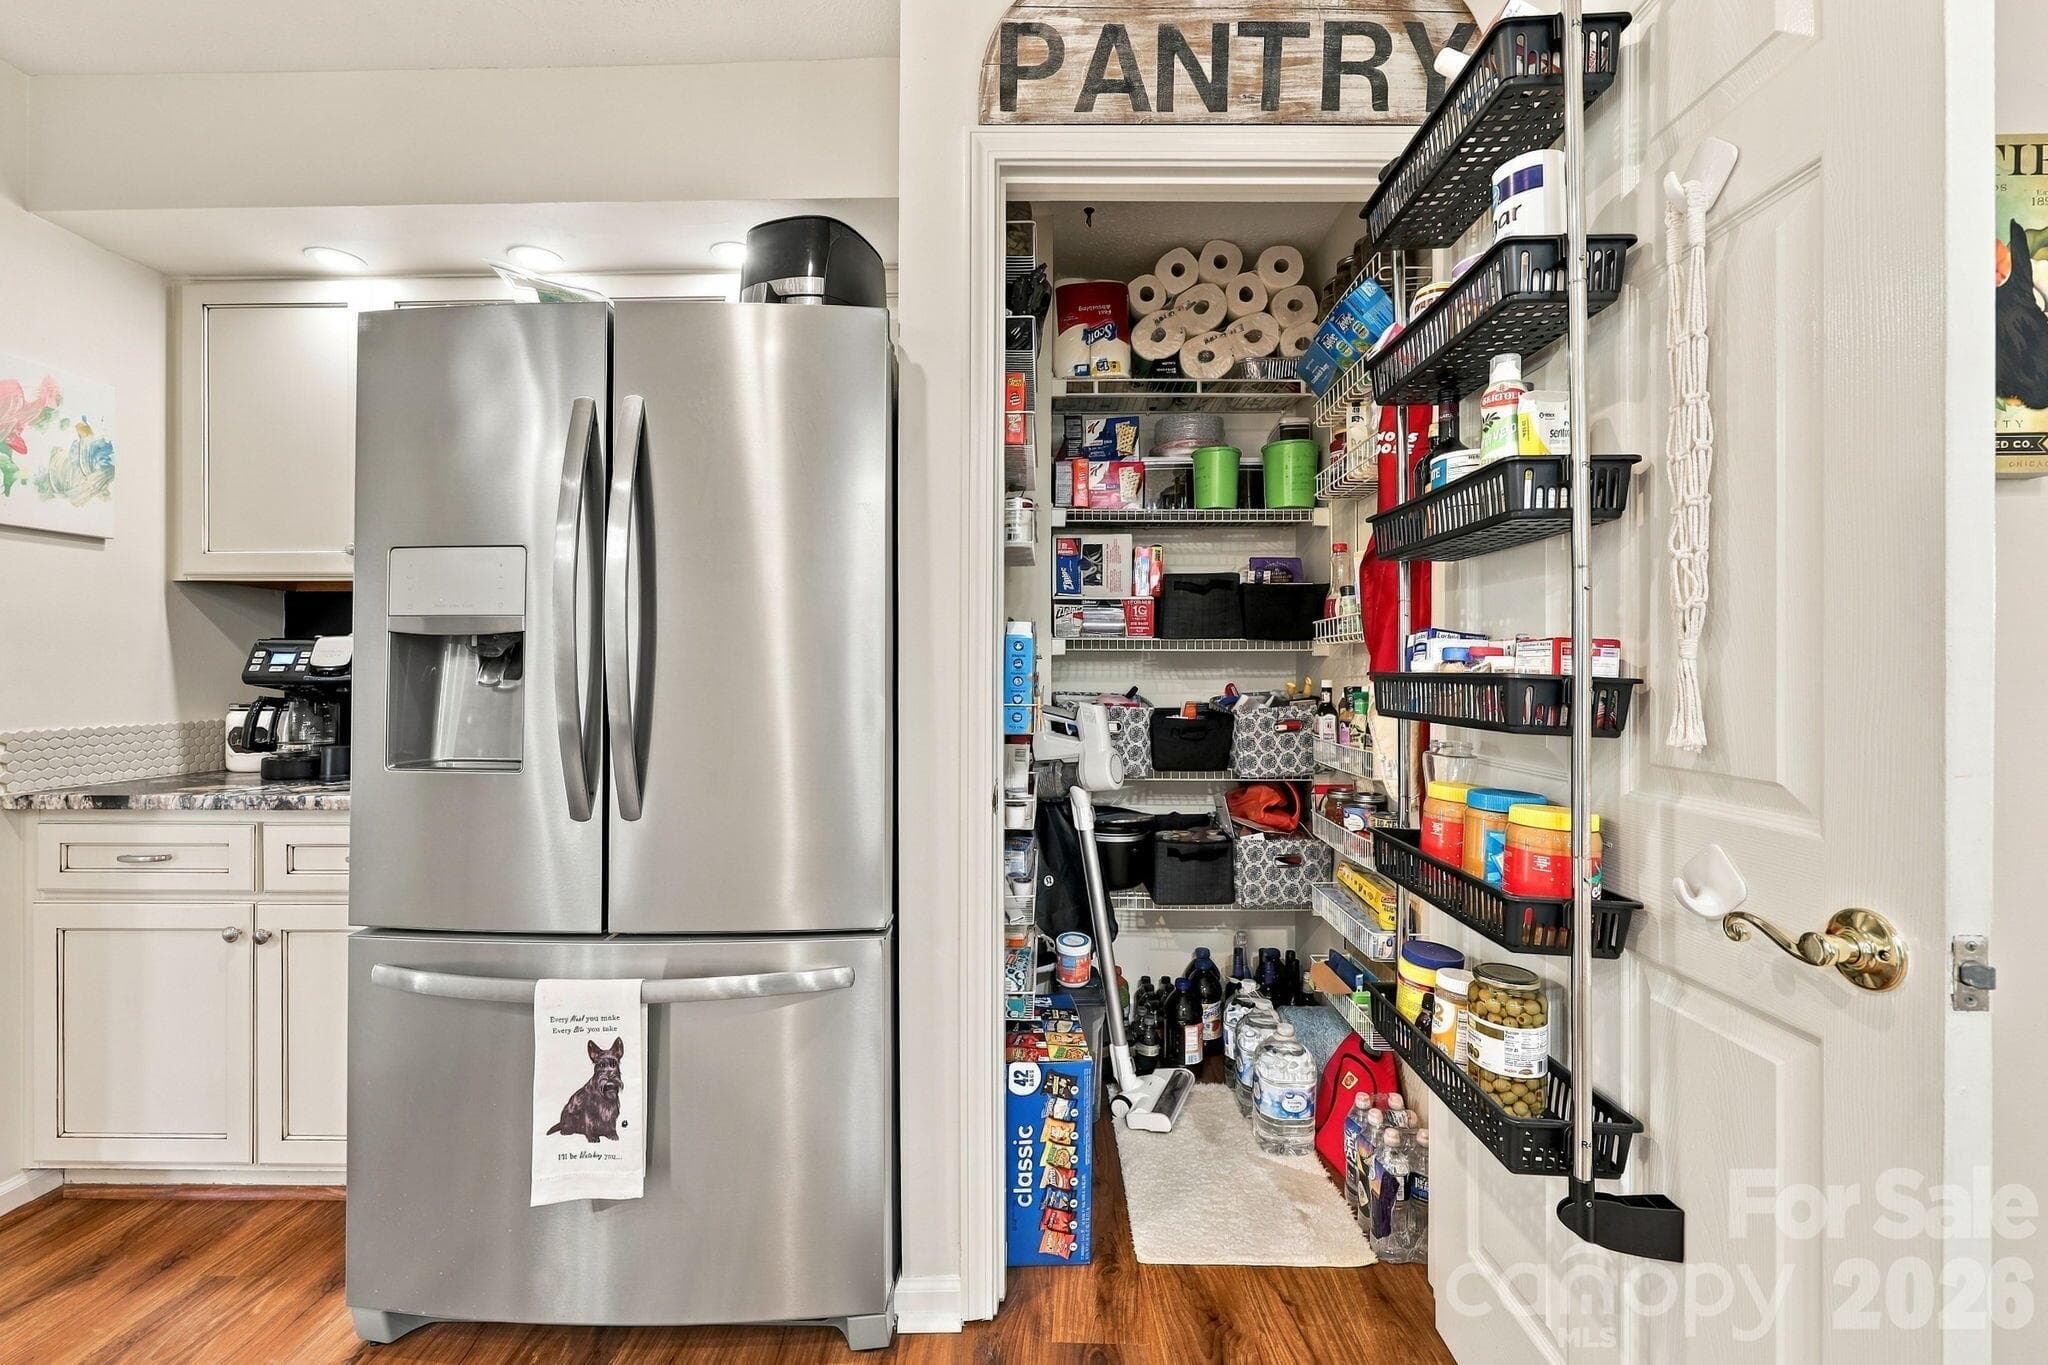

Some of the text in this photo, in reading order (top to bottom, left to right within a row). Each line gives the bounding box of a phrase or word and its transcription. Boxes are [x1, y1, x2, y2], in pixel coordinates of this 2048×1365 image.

[1000, 21, 1478, 112] PANTRY
[1084, 323, 1113, 346] Scott
[2013, 440, 2034, 448] CO.
[1060, 567, 1075, 591] Ziploc
[550, 1016, 568, 1024] Every
[1014, 1067, 1030, 1087] 42
[1013, 1125, 1033, 1208] classic
